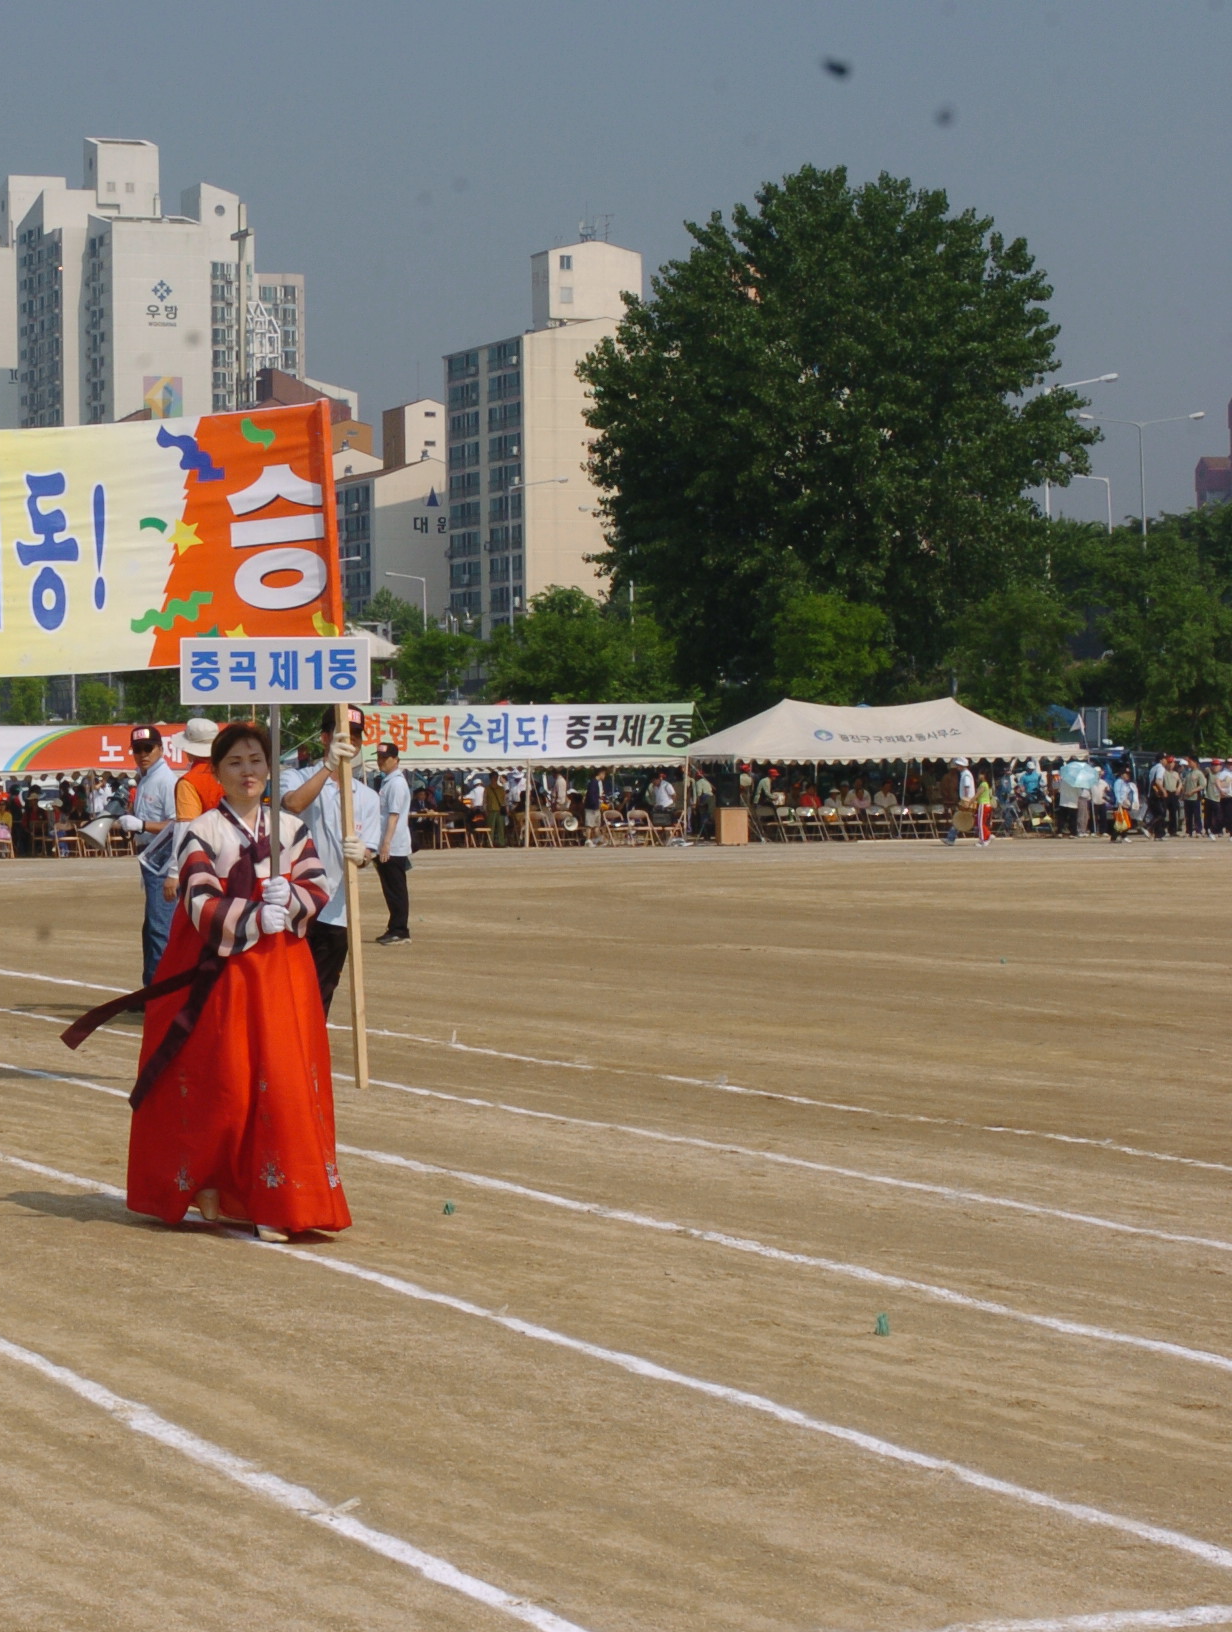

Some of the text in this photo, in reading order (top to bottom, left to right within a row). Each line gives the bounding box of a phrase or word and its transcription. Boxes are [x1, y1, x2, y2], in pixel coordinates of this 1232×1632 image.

[146, 304, 178, 320] 우방
[226, 464, 327, 610] 승
[362, 712, 693, 753] 화합도! 승리도! 중곡제2동
